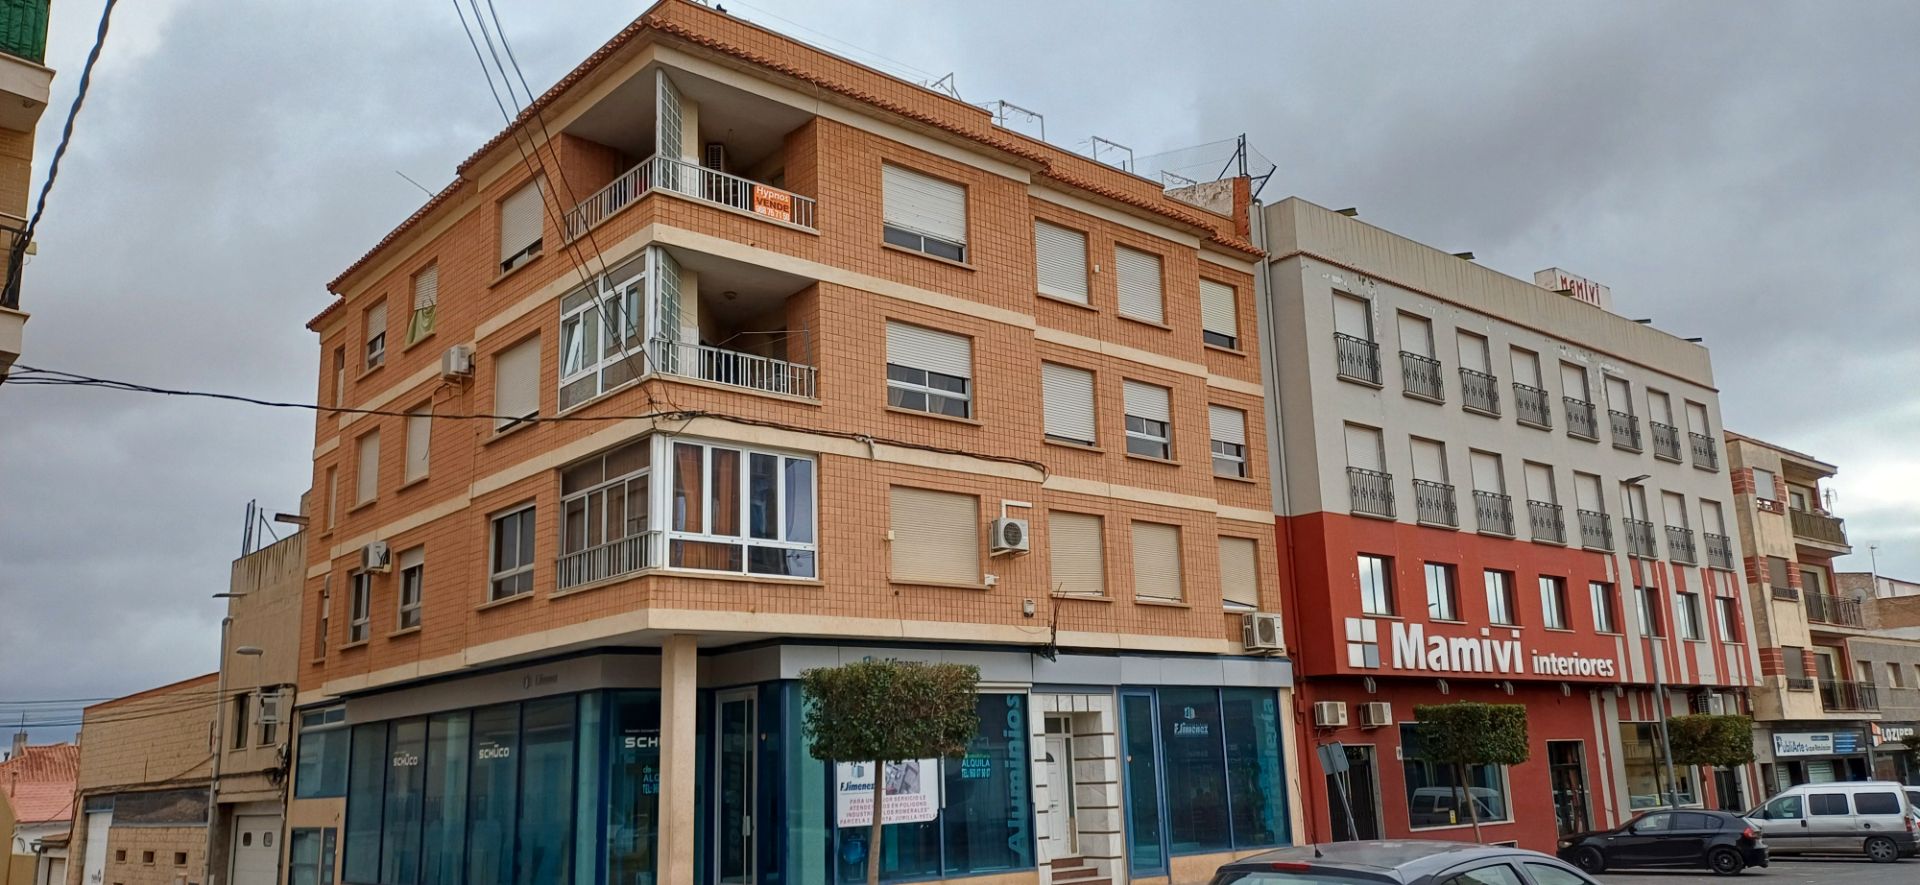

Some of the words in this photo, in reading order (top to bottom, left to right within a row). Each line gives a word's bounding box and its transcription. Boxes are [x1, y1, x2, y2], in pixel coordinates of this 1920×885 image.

[756, 185, 789, 203] Hypnos
[756, 196, 790, 214] VENDE
[1391, 621, 1524, 674] Mamivi
[1531, 649, 1615, 677] interiores
[625, 736, 659, 749] SCH
[962, 758, 990, 768] ALQUILA
[1003, 695, 1030, 867] Aluminios
